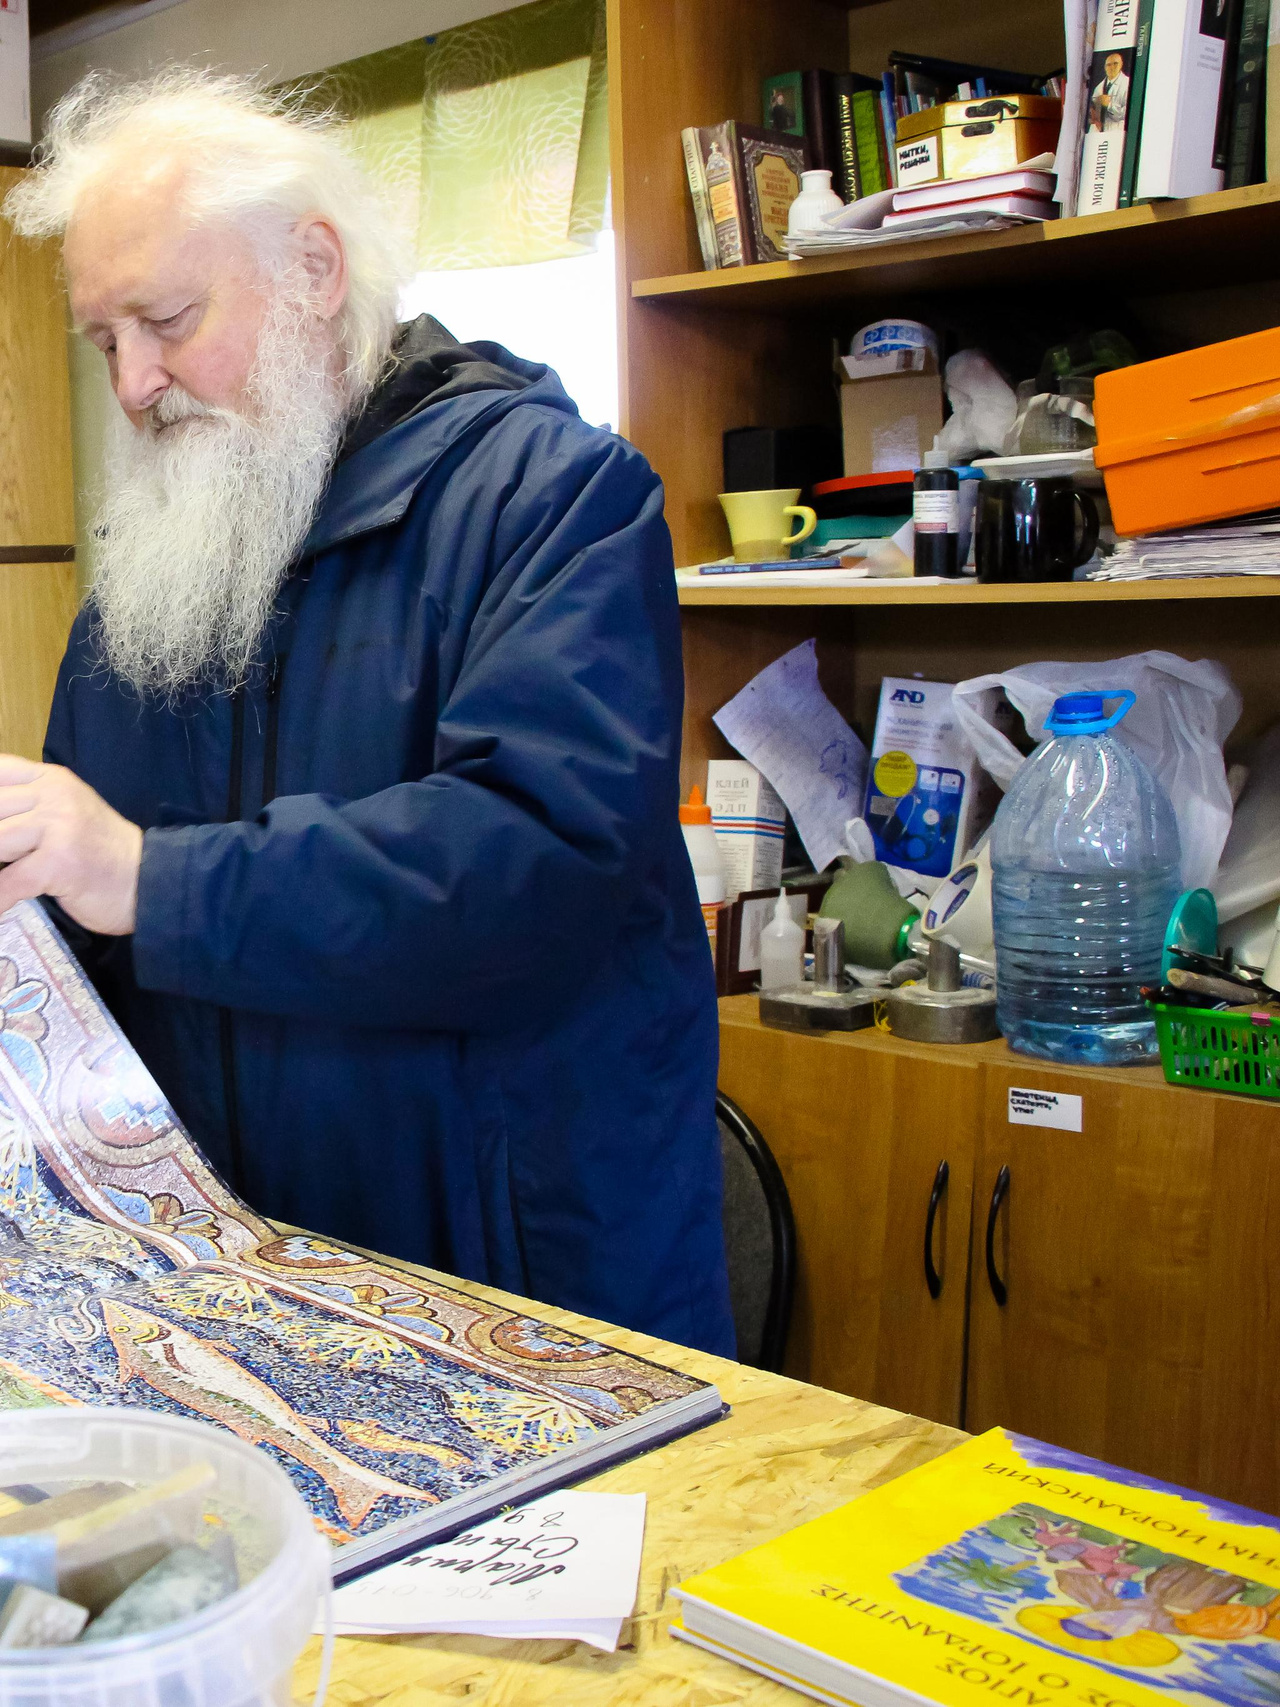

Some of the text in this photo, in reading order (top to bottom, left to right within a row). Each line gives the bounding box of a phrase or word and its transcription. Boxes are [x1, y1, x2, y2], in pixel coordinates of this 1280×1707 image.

[1092, 140, 1109, 206] МОЯ ЖИЗНЬ
[889, 688, 926, 704] AND
[715, 777, 749, 789] КЛЕЙ
[983, 1462, 1207, 1545] ИОРДАНСКИЙ
